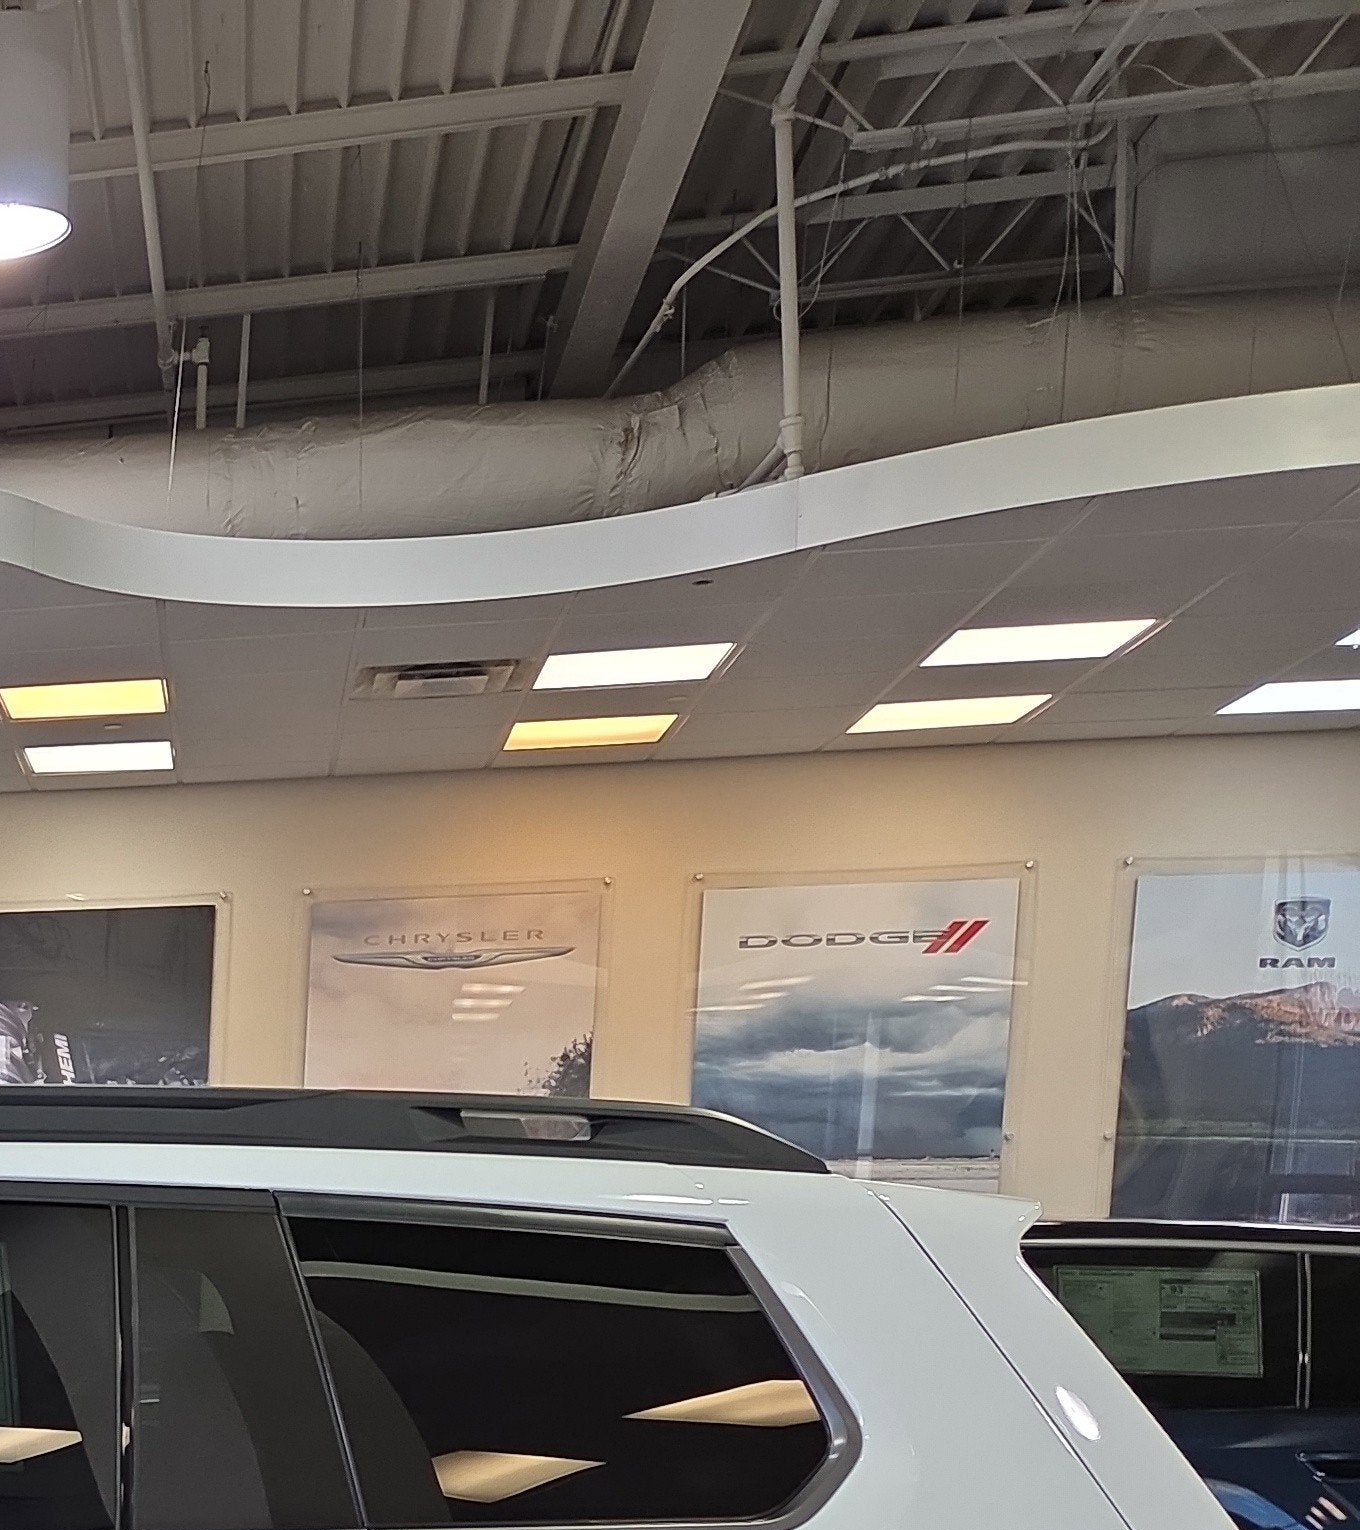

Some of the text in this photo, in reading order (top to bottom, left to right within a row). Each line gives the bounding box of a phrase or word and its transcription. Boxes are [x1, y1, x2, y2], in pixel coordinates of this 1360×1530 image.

[363, 928, 546, 946] CHRYSLER
[738, 929, 952, 949] DODGE
[1259, 957, 1336, 968] RAM
[53, 1033, 76, 1085] HEMI
